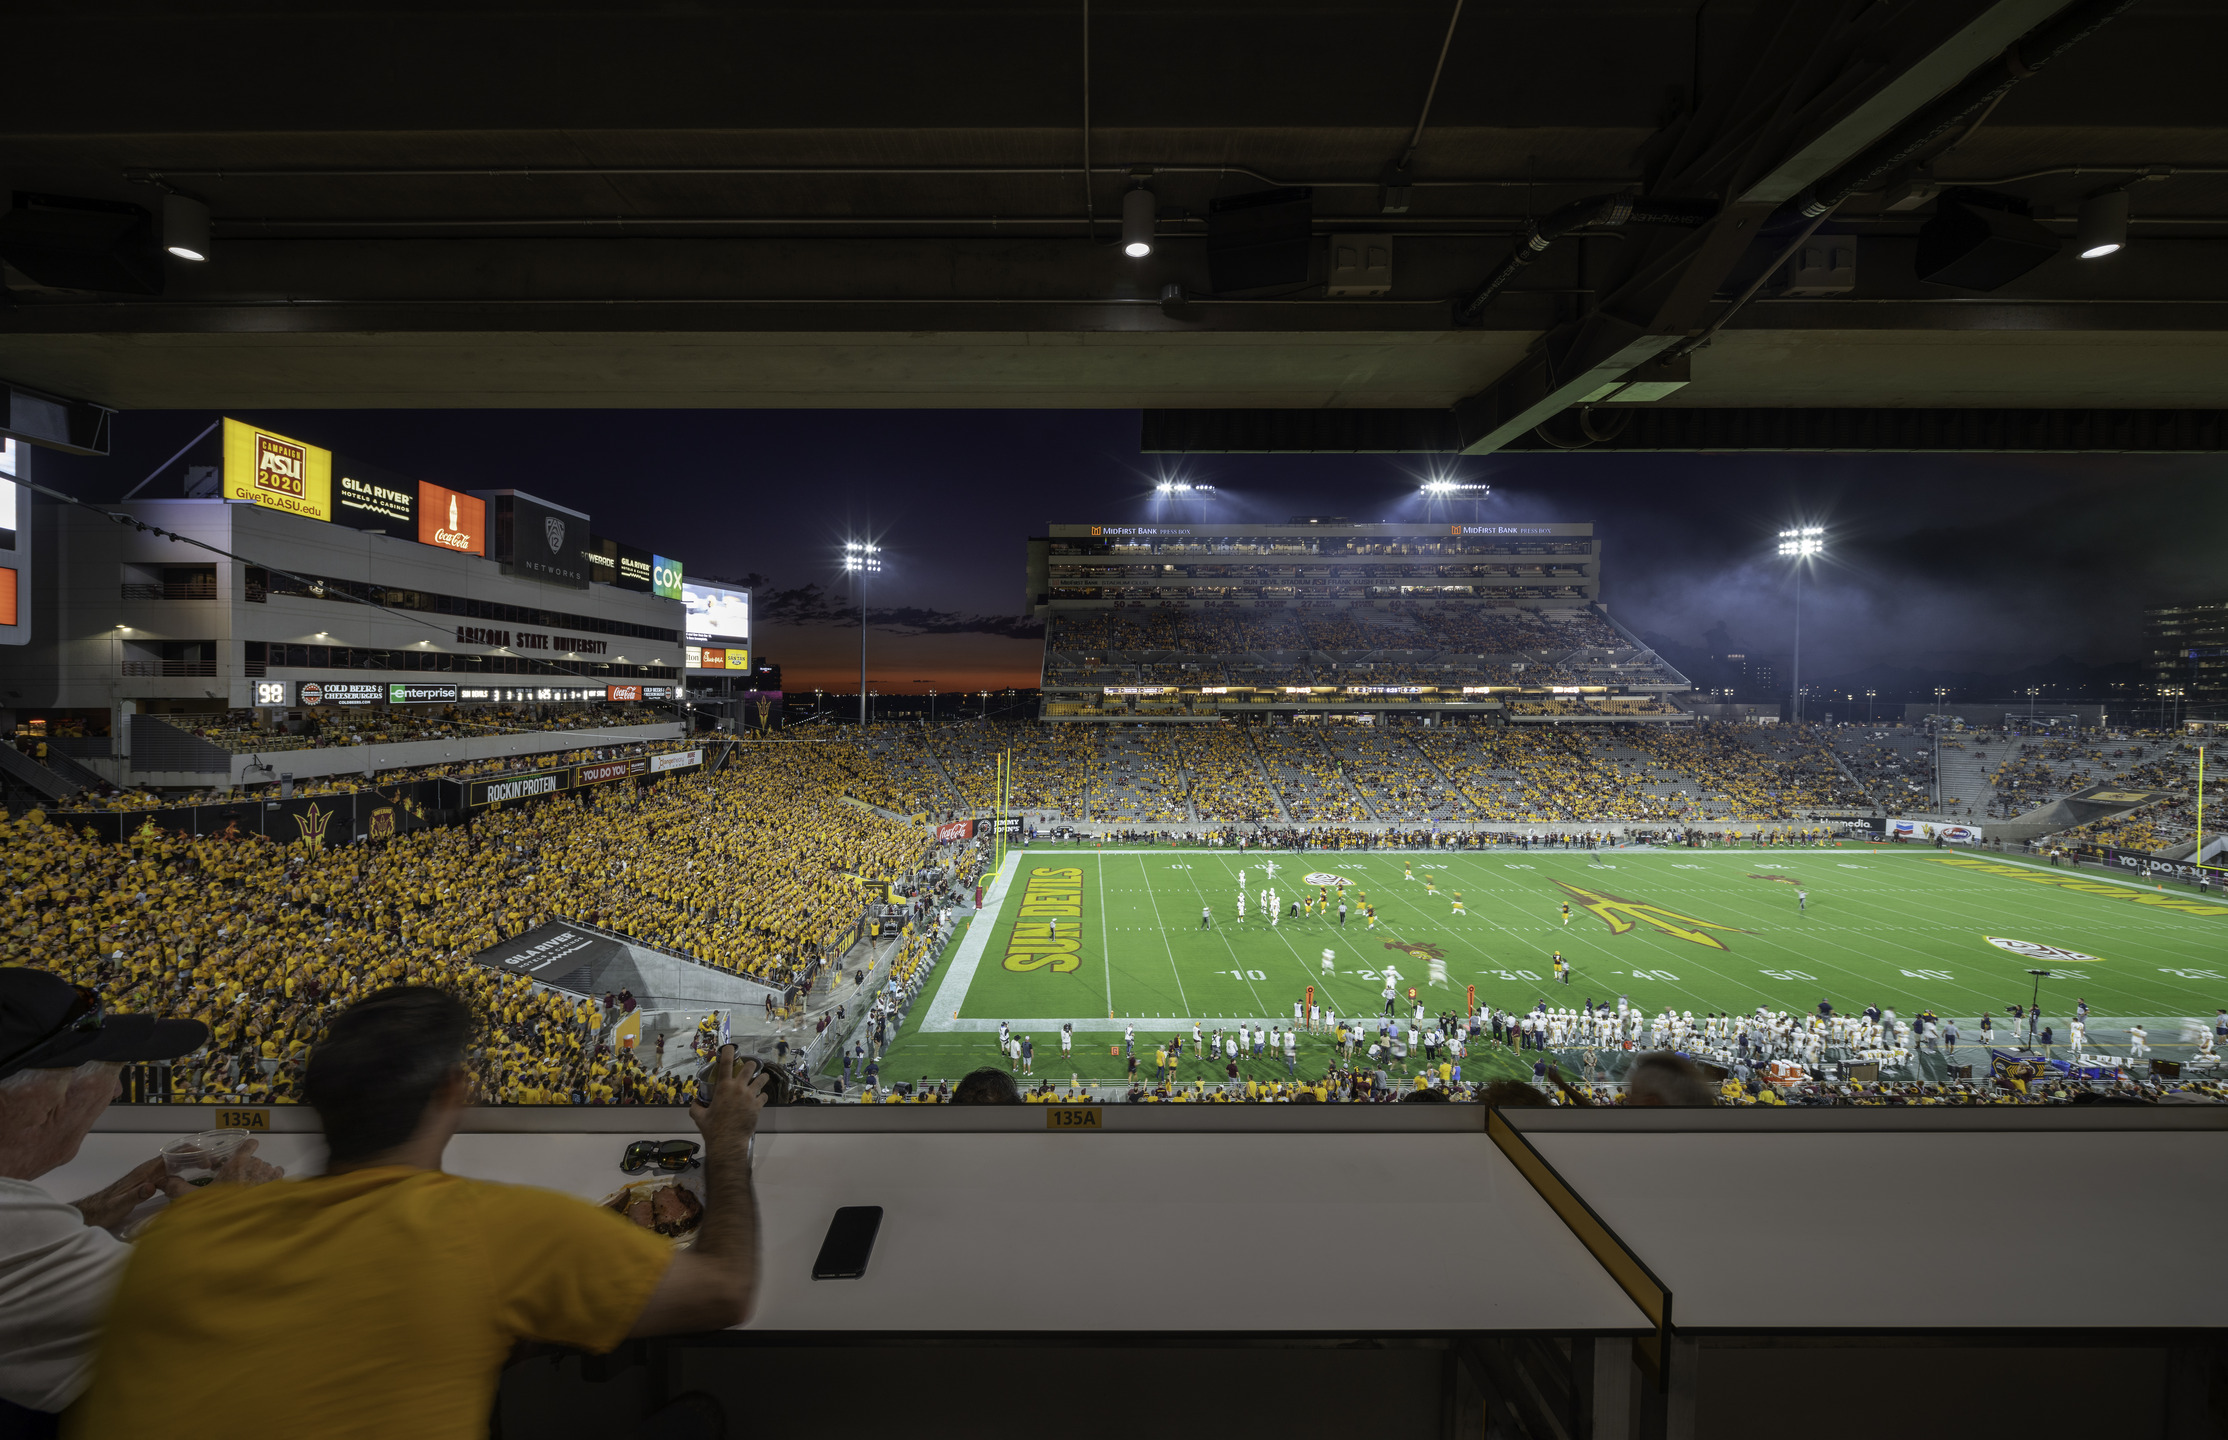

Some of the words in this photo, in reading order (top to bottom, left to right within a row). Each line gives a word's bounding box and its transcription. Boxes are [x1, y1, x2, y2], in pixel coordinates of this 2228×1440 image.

[262, 440, 301, 460] CAMPAIGN
[260, 450, 302, 480] ASU
[260, 471, 301, 493] 2020
[341, 477, 370, 495] GILA
[374, 486, 410, 506] RIVER
[236, 488, 321, 517] GiveTo.ASU.edu
[341, 490, 370, 502] HOTELS
[380, 500, 410, 513] CASINOS
[434, 528, 471, 549] Coca-Cola
[526, 560, 581, 580] NETWORKS
[621, 558, 634, 567] GILA
[653, 566, 682, 591] COX
[457, 626, 511, 647] ARIZONA
[516, 632, 549, 650] STATE
[553, 636, 608, 655] UNIVERSITY
[324, 685, 348, 693] COLD
[350, 685, 376, 693] BEERS
[393, 688, 455, 700] enterprise
[462, 690, 470, 698] SUN
[472, 690, 488, 698] DEVILS
[613, 686, 637, 700] Coca-Cola
[583, 767, 599, 782] YOU
[600, 767, 612, 779] DO
[611, 764, 626, 776] YOU
[487, 781, 522, 803] ROCKIN'
[522, 776, 556, 798] PROTEIN
[940, 822, 968, 842] Coca-Cola
[2151, 860, 2173, 872] DO
[1016, 867, 1084, 918] DEVILS
[504, 949, 541, 966] GILA
[537, 931, 575, 951] RIVER
[518, 954, 547, 968] HOTELS
[555, 936, 584, 952] CASINOS
[1001, 920, 1082, 974] SUN
[1230, 970, 1267, 981] 10
[1489, 969, 1543, 981] 30
[1632, 969, 1680, 981] 40
[1759, 969, 1818, 981] 50
[1899, 969, 1954, 980] 40
[2158, 968, 2227, 980] 20
[1409, 989, 1415, 997] 3
[222, 1112, 264, 1127] 135A
[1054, 1111, 1096, 1125] 135A
